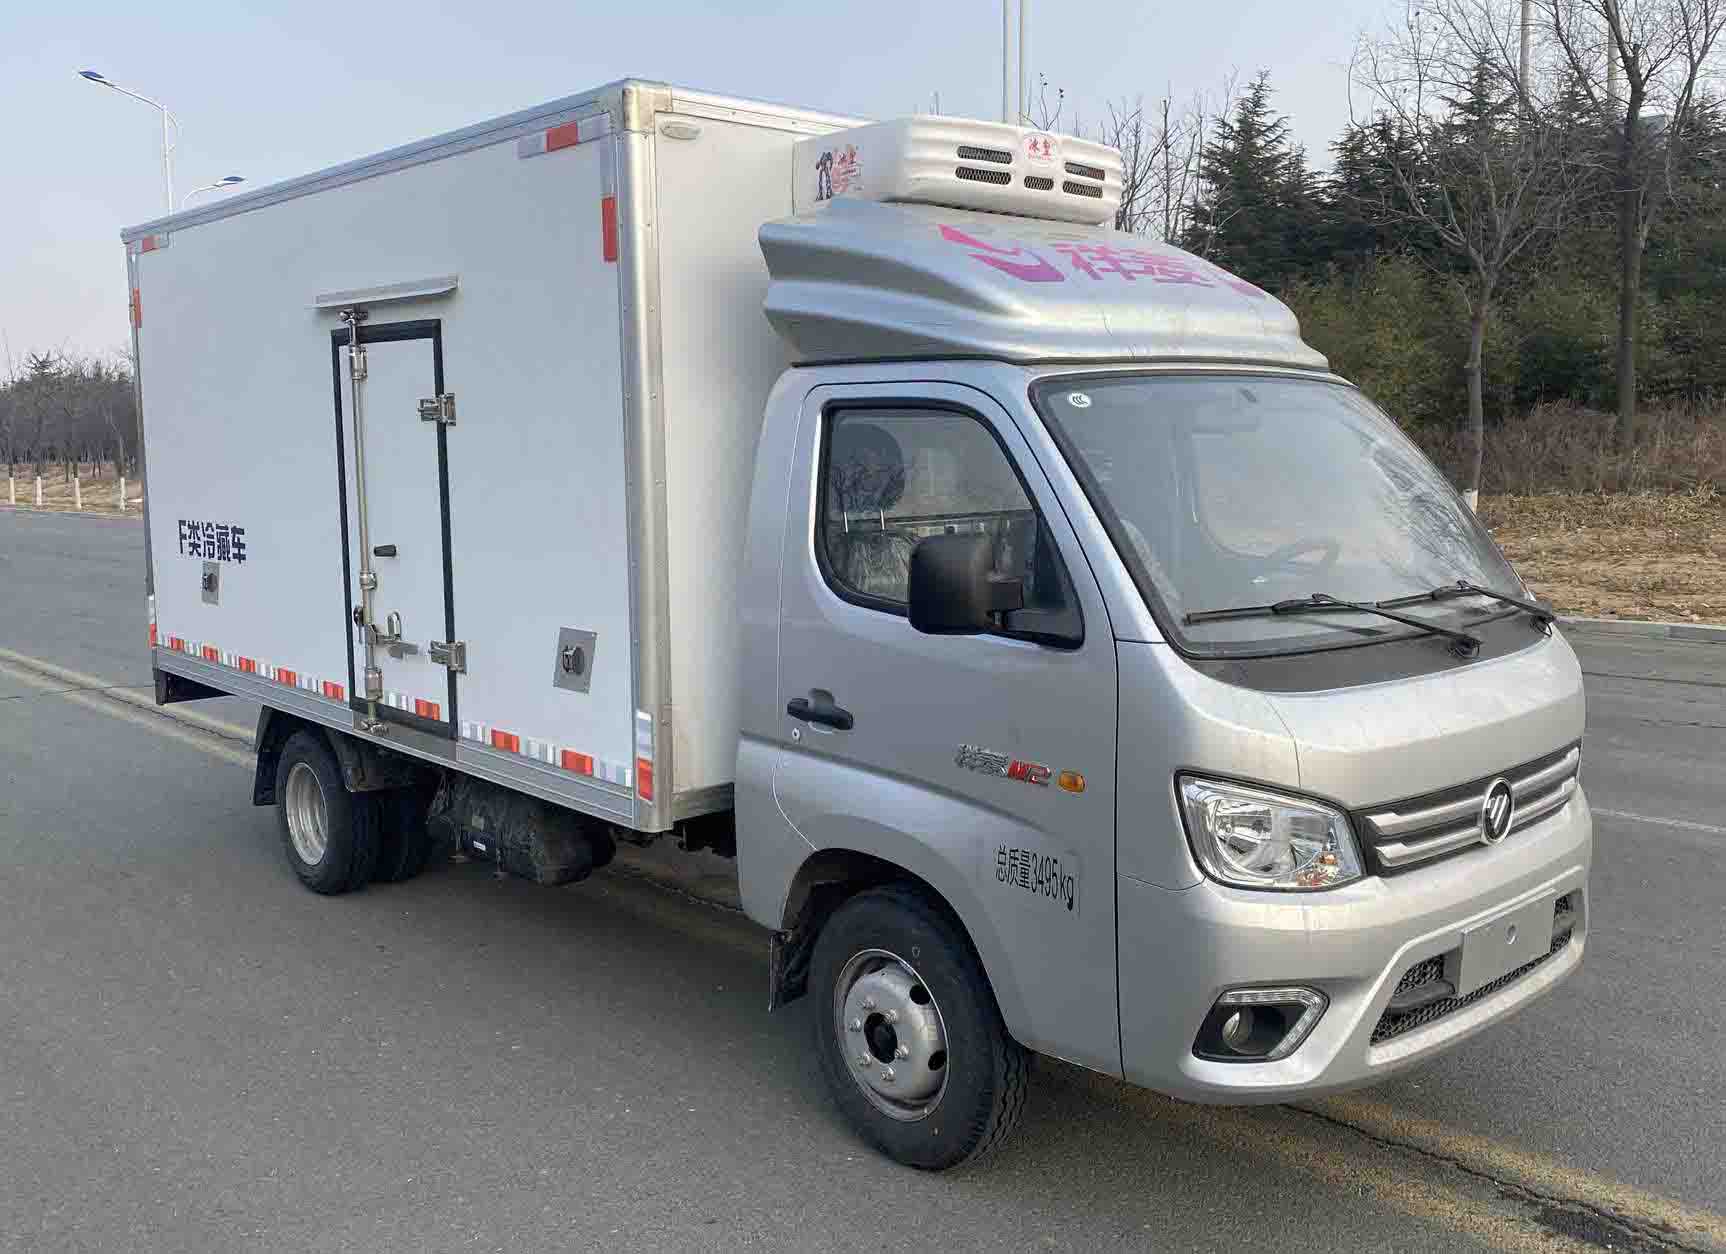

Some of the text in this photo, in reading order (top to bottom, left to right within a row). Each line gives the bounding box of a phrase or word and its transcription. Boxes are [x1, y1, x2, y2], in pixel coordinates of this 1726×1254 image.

[177, 519, 247, 564] F类冷藏车
[995, 842, 1075, 911] 总质量3495kg
